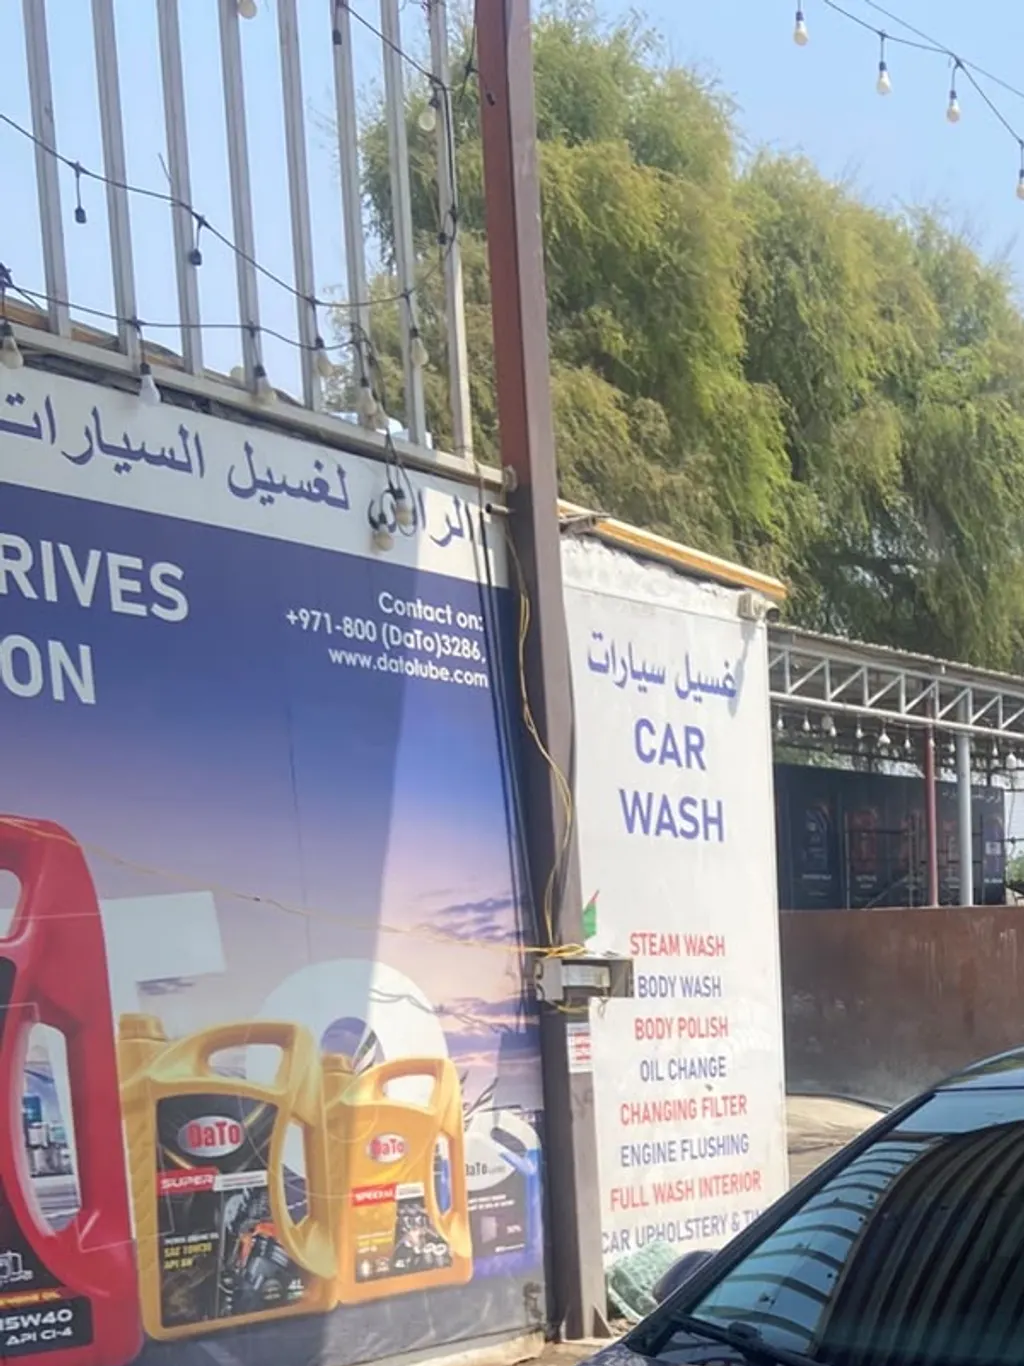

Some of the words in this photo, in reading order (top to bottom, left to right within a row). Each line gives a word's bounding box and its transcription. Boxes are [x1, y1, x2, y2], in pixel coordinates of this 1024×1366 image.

[228, 441, 350, 510] لغسيل
[0, 533, 189, 622] RIVES
[286, 608, 377, 643] +971-800
[378, 591, 452, 625] Contact
[456, 611, 484, 632] on:
[0, 634, 96, 705] ON
[328, 648, 490, 689] www.datolube.com
[587, 631, 666, 693] سيارات
[675, 650, 737, 703] غسيل
[634, 718, 706, 771] CAR
[618, 788, 724, 842] WASH
[629, 931, 681, 957] STEAM
[684, 935, 726, 957] WASH
[637, 974, 677, 999] BODY
[680, 975, 722, 999] WASH
[634, 1017, 673, 1041] BODY
[677, 1016, 729, 1040] POLISH
[639, 1059, 664, 1082] OIL
[668, 1056, 727, 1081] CHANGE
[620, 1096, 697, 1126] CHANGING
[702, 1094, 748, 1119] FILTER
[187, 1121, 242, 1148] DaTo
[620, 1140, 677, 1168] ENGINE
[680, 1133, 749, 1162] FLUSHING
[160, 1173, 214, 1190] SUPER
[610, 1186, 649, 1212] FULL
[652, 1179, 694, 1205] WASH
[699, 1170, 762, 1199] INTERIOR
[601, 1228, 631, 1255] CAR
[635, 1213, 728, 1249] UPHOLSTERY
[5, 1331, 37, 1346] API
